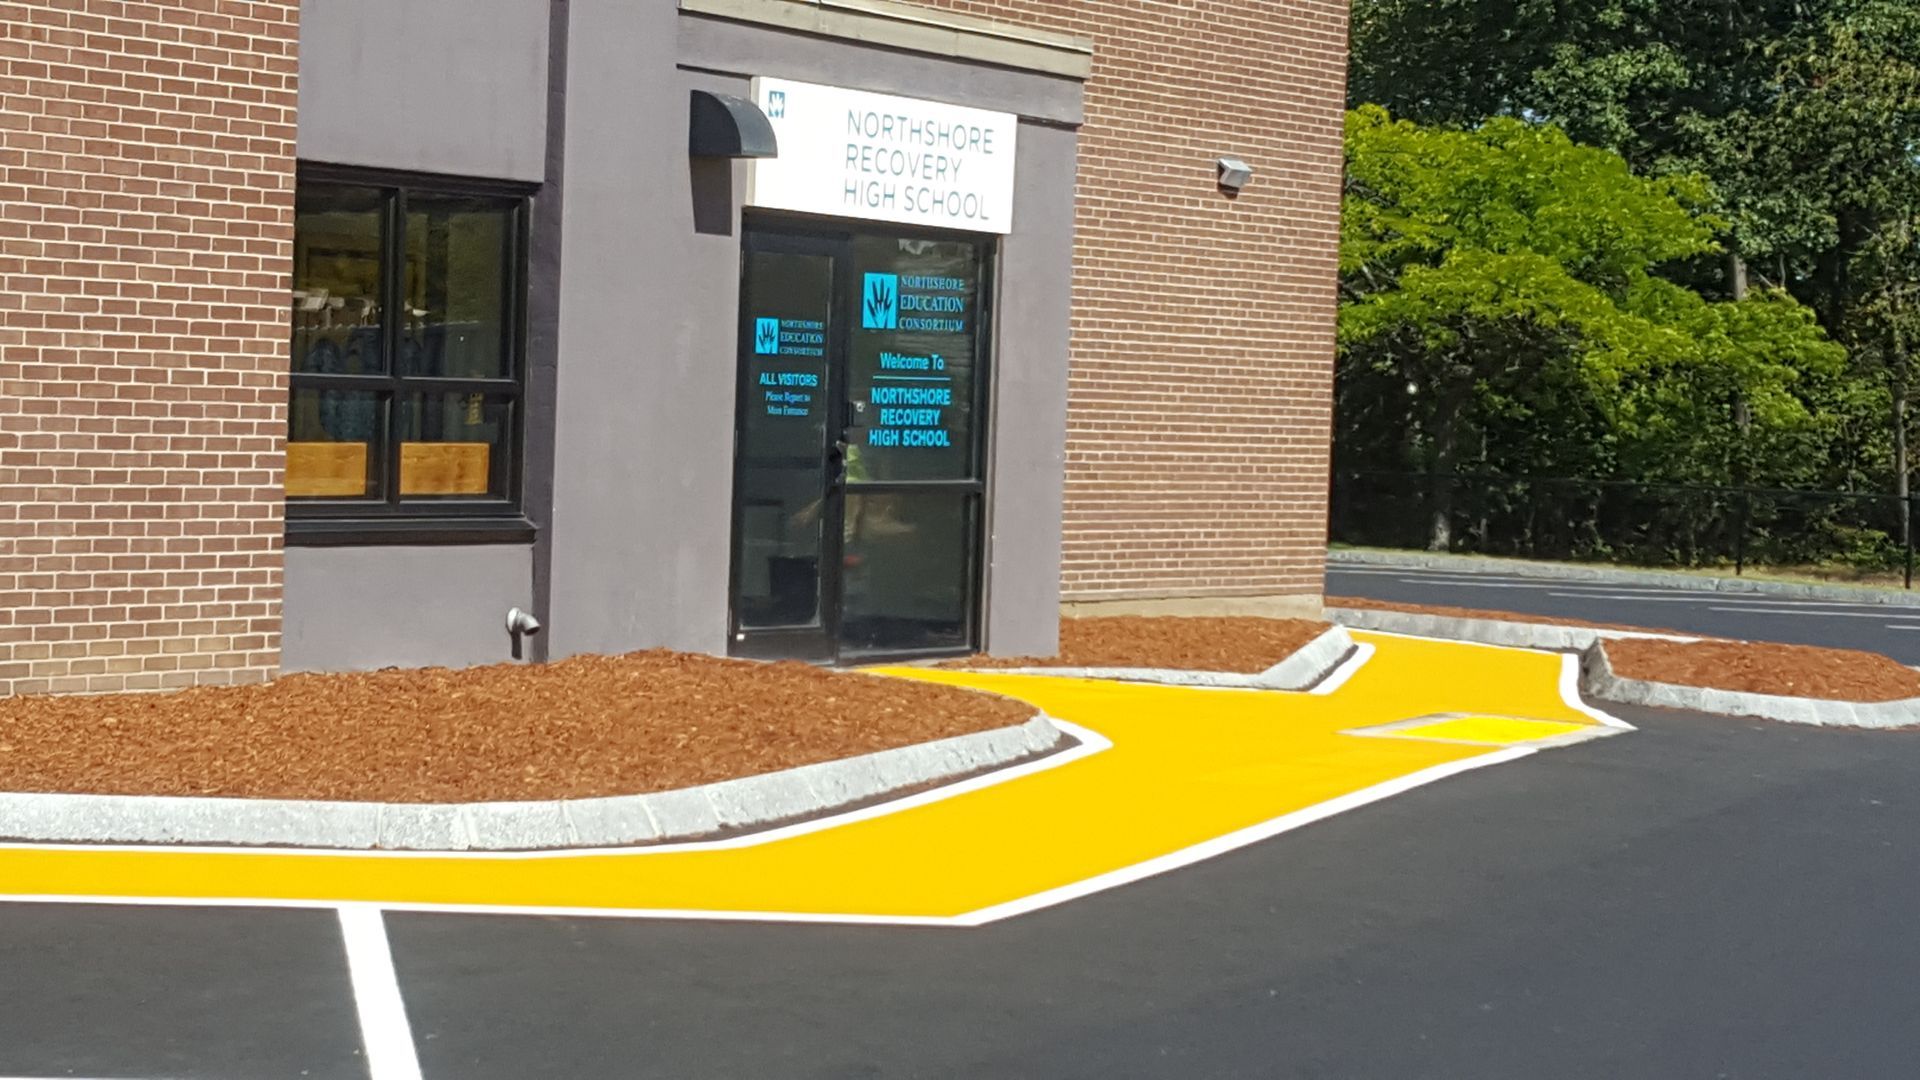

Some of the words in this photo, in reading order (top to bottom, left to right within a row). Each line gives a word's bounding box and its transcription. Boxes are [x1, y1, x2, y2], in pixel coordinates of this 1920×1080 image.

[847, 109, 994, 154] NORTHSHORE
[846, 143, 962, 182] RECOVERY
[844, 178, 896, 209] HIGH
[904, 185, 989, 220] SCHOOL
[901, 275, 965, 291] NORTHSHORE
[900, 294, 964, 312] EDUCATION
[899, 317, 964, 332] CONSORTIUM
[880, 352, 929, 370] Welcome
[931, 354, 944, 370] To
[759, 372, 777, 385] ALL
[778, 372, 818, 387] VISITORS
[871, 387, 951, 405] NORTHSHORE
[880, 408, 940, 426] RECOVERY
[869, 429, 899, 446] HIGH
[902, 429, 951, 447] SCHOOL
